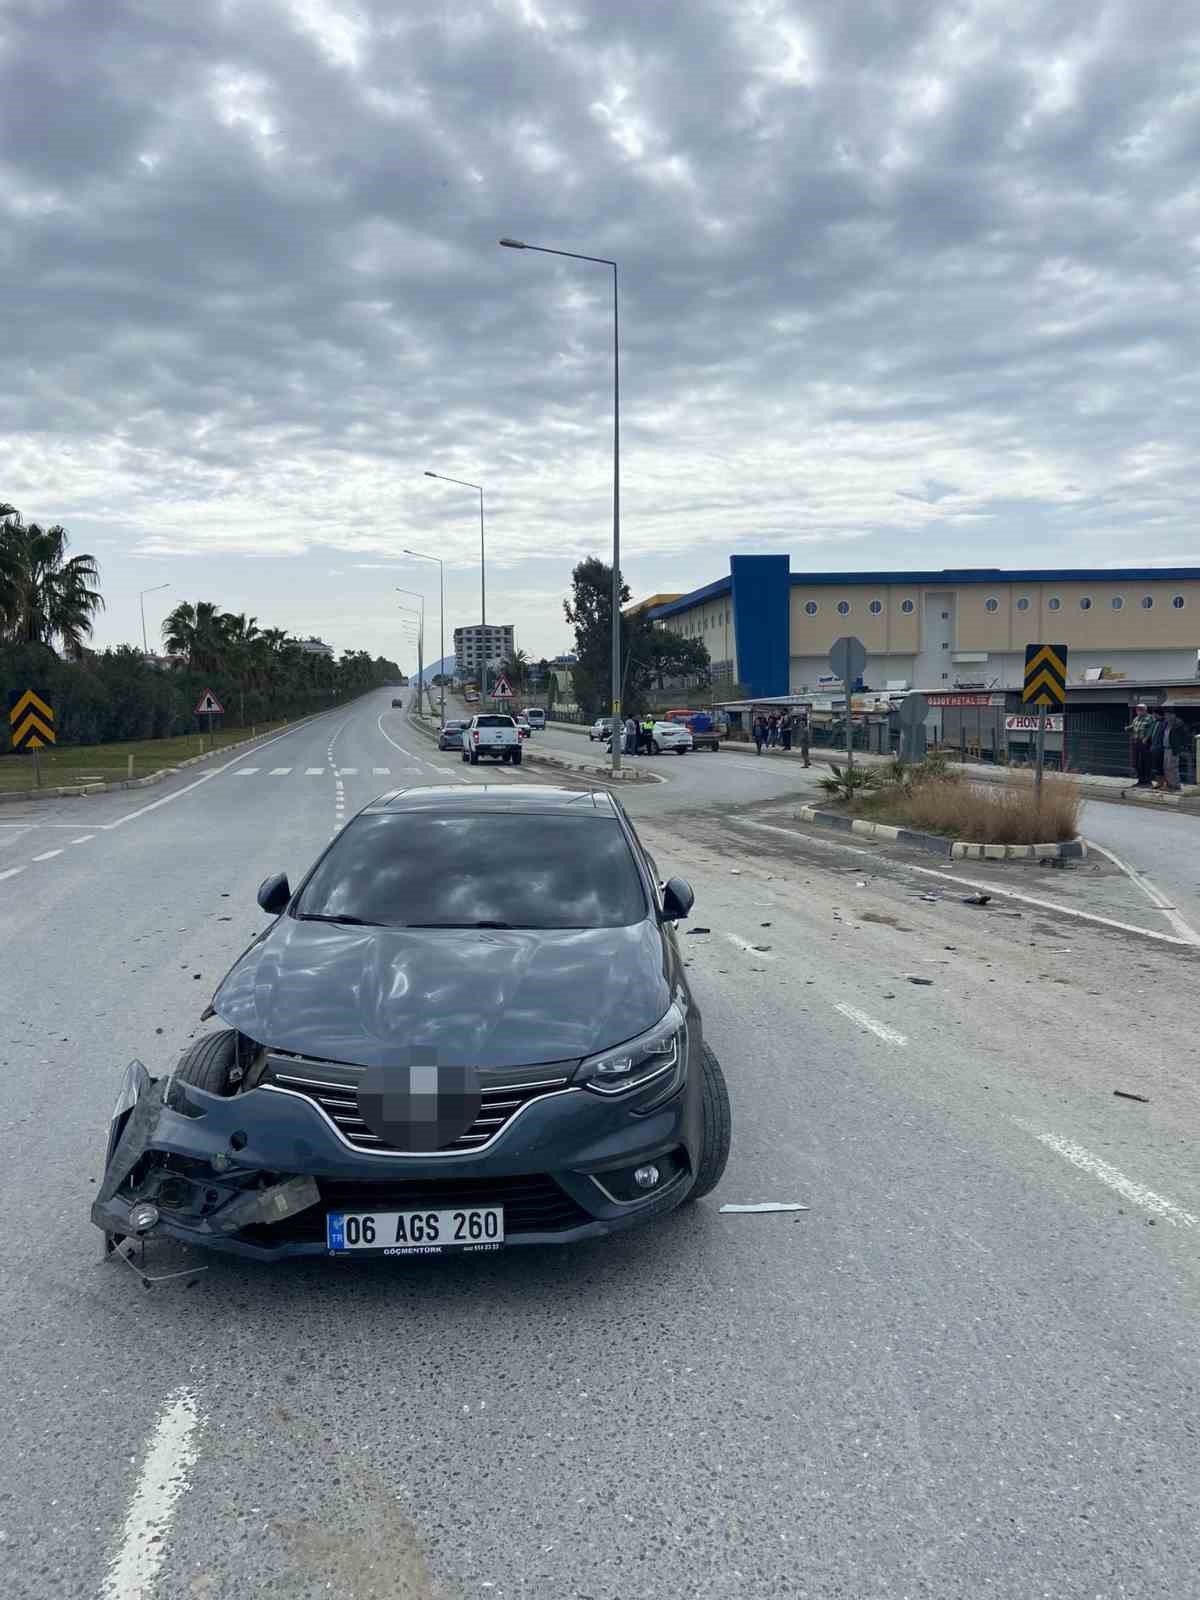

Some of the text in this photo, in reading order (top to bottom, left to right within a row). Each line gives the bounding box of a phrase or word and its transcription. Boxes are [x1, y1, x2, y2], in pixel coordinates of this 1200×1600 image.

[1016, 717, 1053, 729] HONA
[346, 1211, 498, 1245] 06 AGS 260
[331, 1234, 344, 1243] TR
